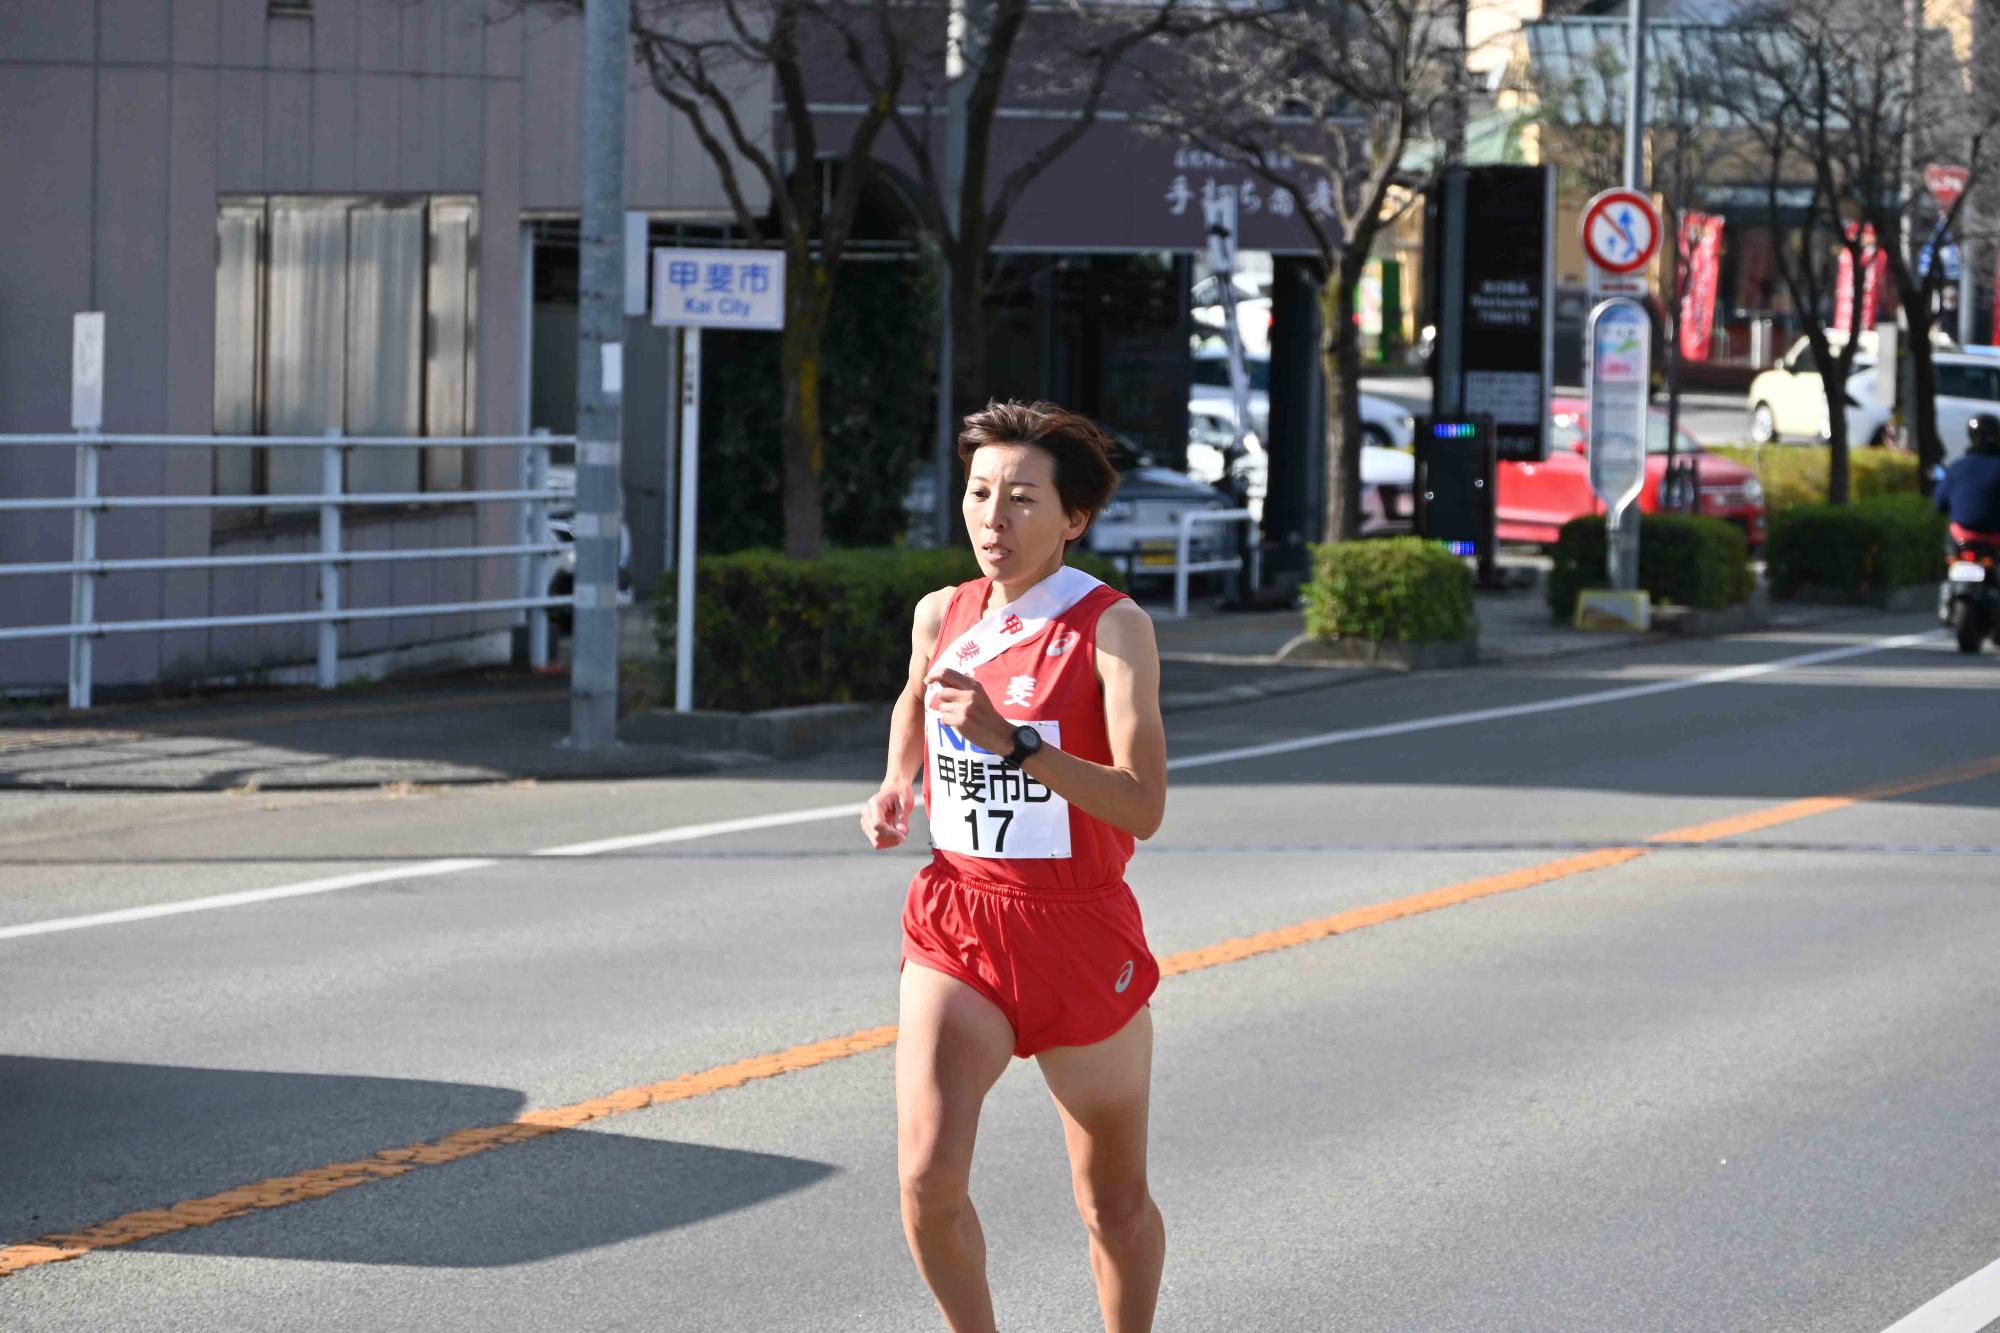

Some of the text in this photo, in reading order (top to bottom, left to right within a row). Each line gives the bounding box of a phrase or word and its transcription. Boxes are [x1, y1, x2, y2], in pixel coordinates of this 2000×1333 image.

[669, 261, 770, 293] 甲斐市
[684, 297, 752, 317] Kai City
[964, 808, 1014, 853] 17
